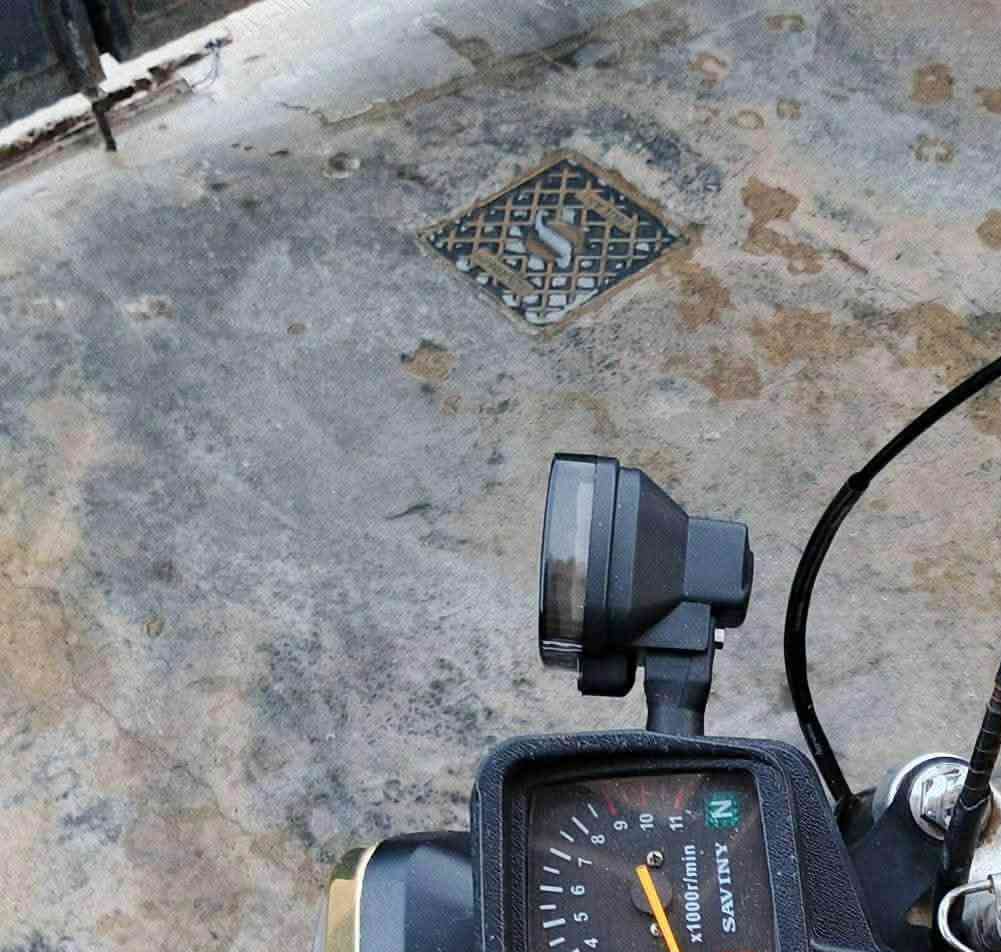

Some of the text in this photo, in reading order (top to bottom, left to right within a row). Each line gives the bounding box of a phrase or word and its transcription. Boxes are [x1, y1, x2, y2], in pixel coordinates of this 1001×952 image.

[711, 799, 733, 818] N
[614, 820, 628, 830] 9
[640, 813, 654, 831] 10
[669, 815, 685, 831] 11
[591, 834, 606, 844] 8
[578, 857, 593, 867] 7
[571, 885, 585, 895] 6
[715, 842, 736, 933] SAVINY
[681, 844, 703, 943] x1000r/min
[574, 912, 588, 922] 5
[584, 938, 599, 948] 4
